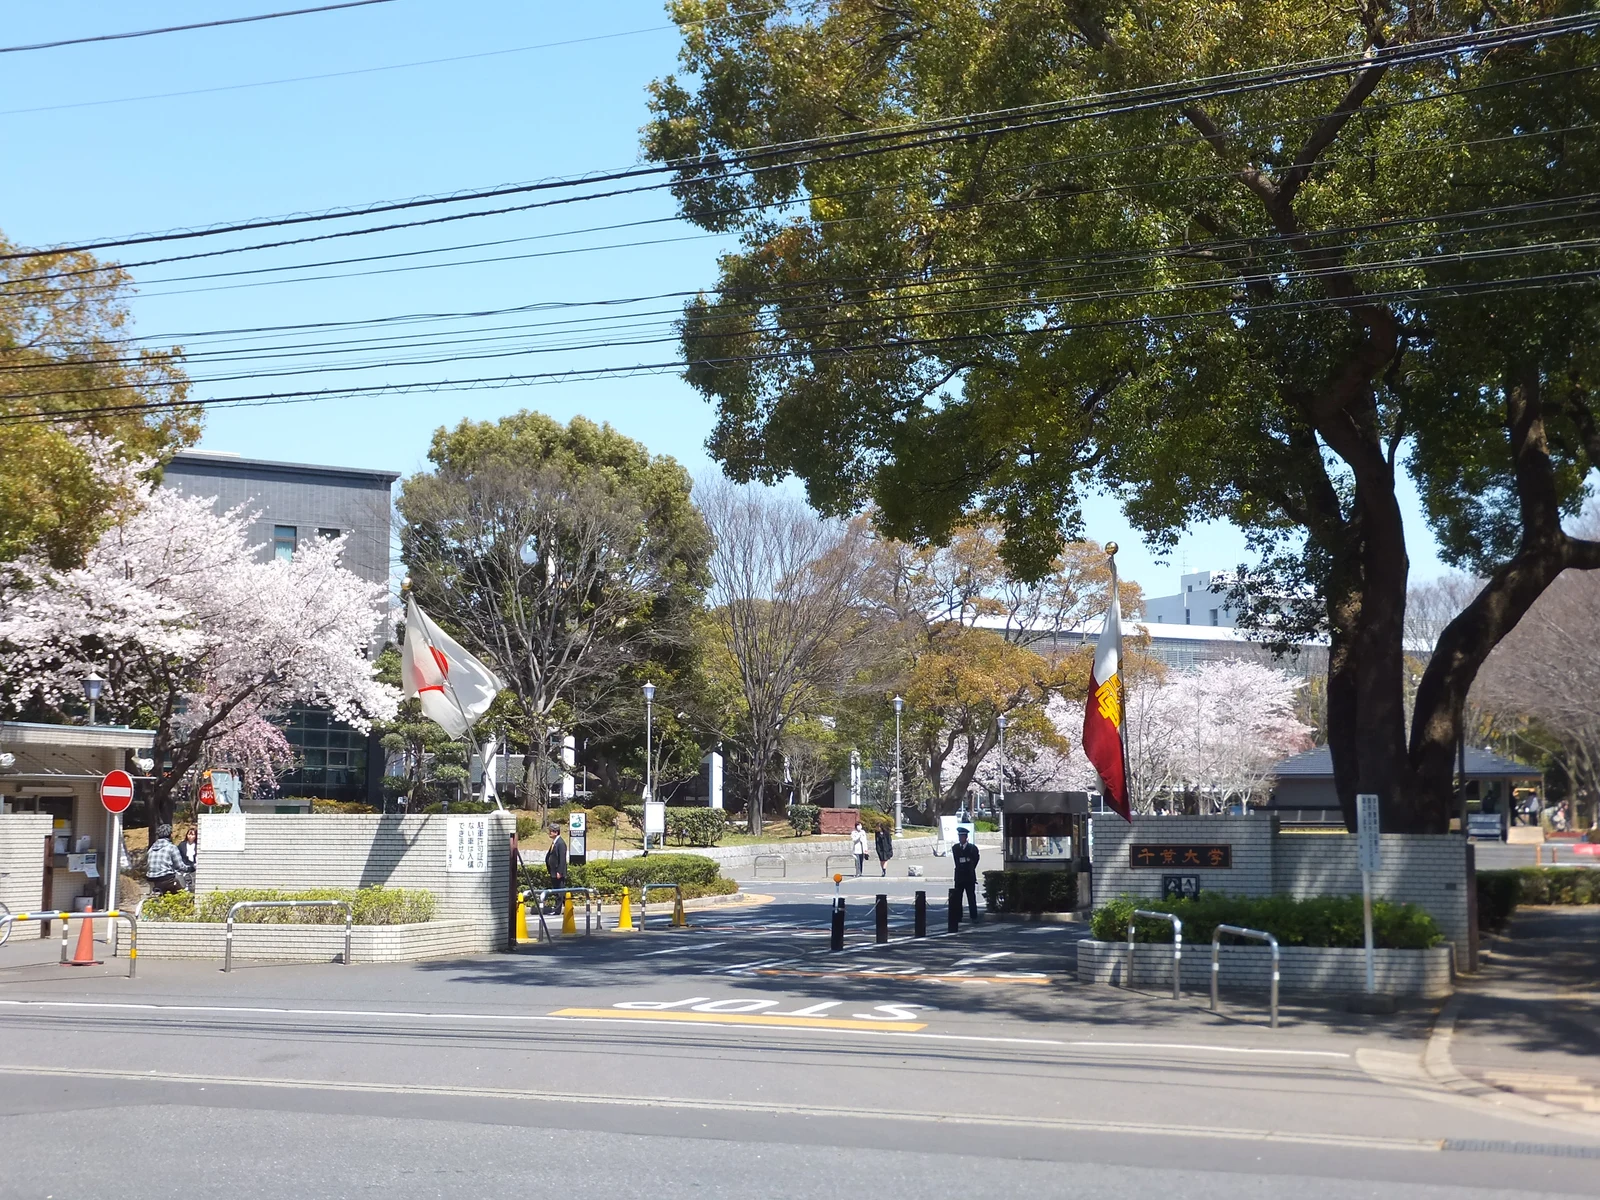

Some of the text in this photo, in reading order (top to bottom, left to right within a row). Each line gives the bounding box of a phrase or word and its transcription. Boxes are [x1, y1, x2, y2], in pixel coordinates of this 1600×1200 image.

[1137, 847, 1225, 866] 千葉大学
[612, 997, 939, 1021] STOP
